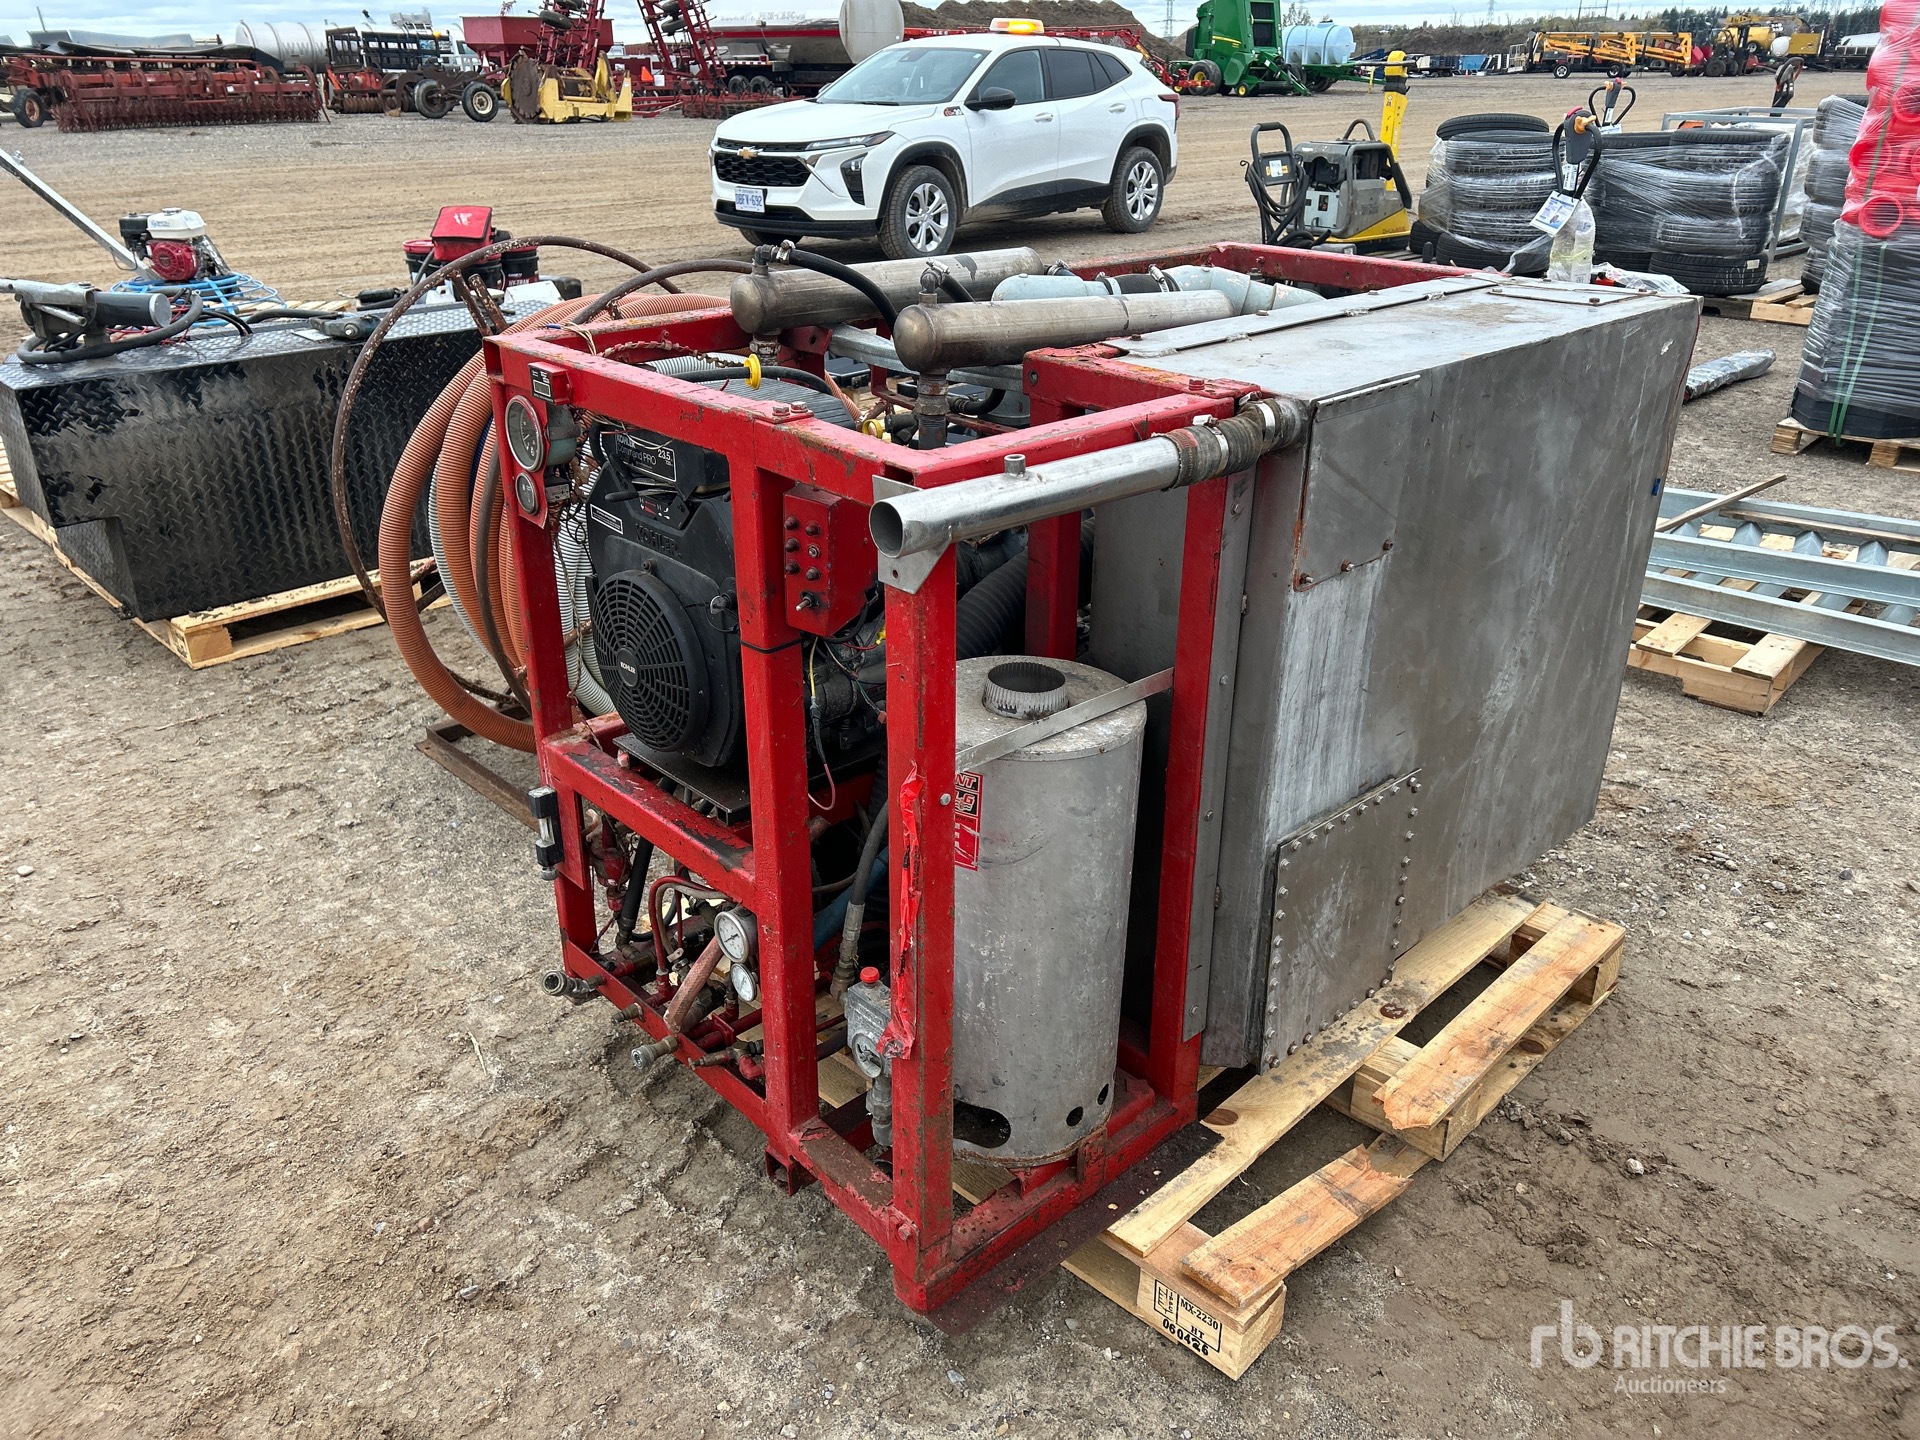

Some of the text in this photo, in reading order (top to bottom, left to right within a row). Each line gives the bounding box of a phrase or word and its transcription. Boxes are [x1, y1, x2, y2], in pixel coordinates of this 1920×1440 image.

[643, 452, 657, 466] PRO
[635, 523, 678, 557] KOHLER
[620, 661, 636, 674] KOHLER
[1180, 1298, 1219, 1331] MX-2230
[1190, 1325, 1205, 1340] HT
